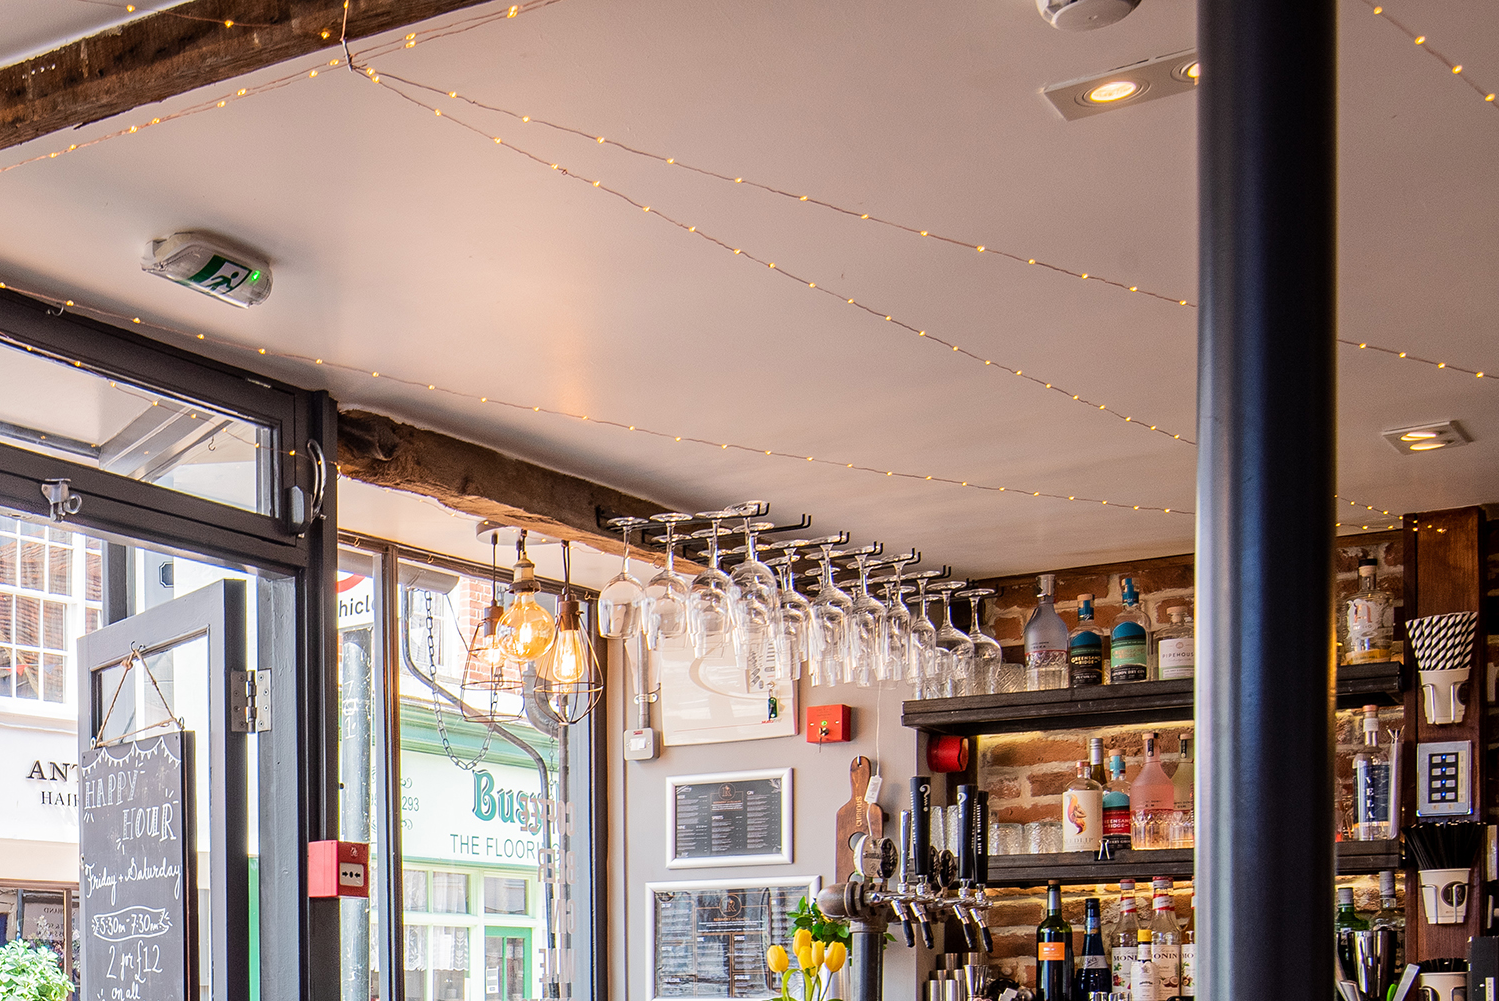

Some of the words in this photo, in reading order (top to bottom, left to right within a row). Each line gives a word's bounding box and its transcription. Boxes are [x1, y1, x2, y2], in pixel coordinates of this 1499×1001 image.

[339, 595, 374, 617] hicl
[84, 770, 139, 810] HAPPY
[402, 796, 419, 812] 293
[122, 803, 177, 843] HOUR
[450, 833, 480, 855] THE
[486, 837, 560, 861] FLOORIG
[85, 863, 117, 906] Friday
[125, 857, 181, 900] Saturday
[106, 945, 117, 979] 2
[121, 952, 134, 981] for
[135, 940, 163, 983] £12
[112, 987, 125, 1001] on
[126, 981, 140, 1000] all
